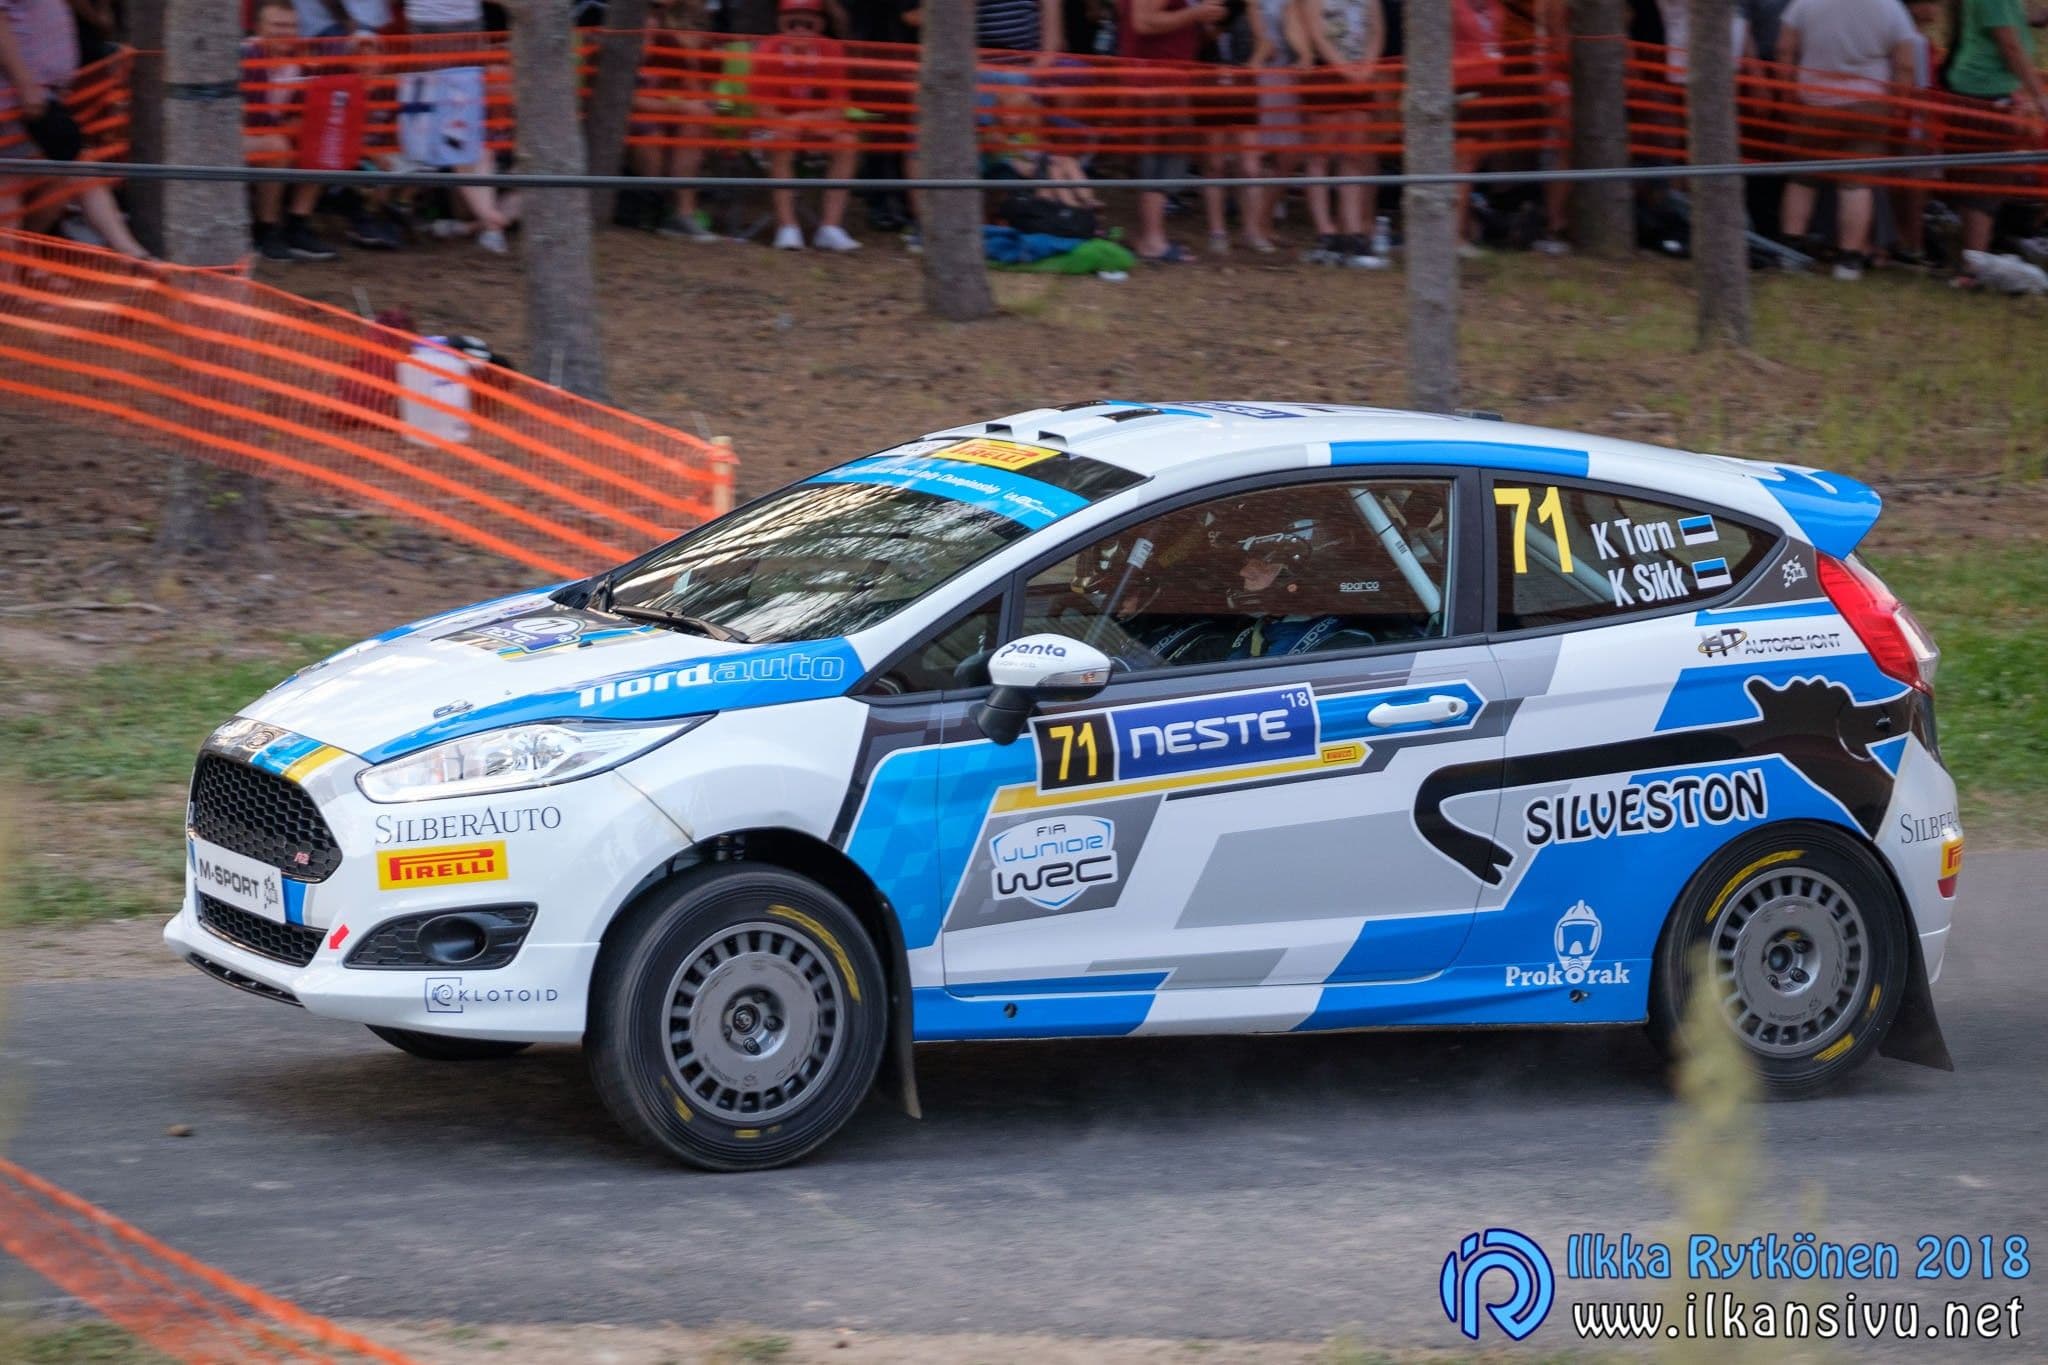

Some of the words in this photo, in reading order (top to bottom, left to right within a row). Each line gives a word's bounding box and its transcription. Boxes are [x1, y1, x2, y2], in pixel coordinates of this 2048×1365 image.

[1493, 486, 1574, 574] 71
[1590, 521, 1619, 561] K
[1619, 518, 1677, 556] Torn
[1607, 568, 1636, 608] K
[1633, 560, 1690, 603] Sikk
[1000, 643, 1067, 658] panta
[1745, 633, 1840, 655] AUTOREMONT
[576, 653, 846, 708] nordauto
[1049, 721, 1098, 781] 71
[1128, 707, 1293, 760] NESTE
[1524, 769, 1766, 847] SILVESTON
[1003, 835, 1104, 863] JUNIOR
[1037, 824, 1067, 837] FIA
[389, 848, 495, 881] PIRELLI
[997, 855, 1113, 895] WRC
[458, 989, 559, 1003] KLOTOID
